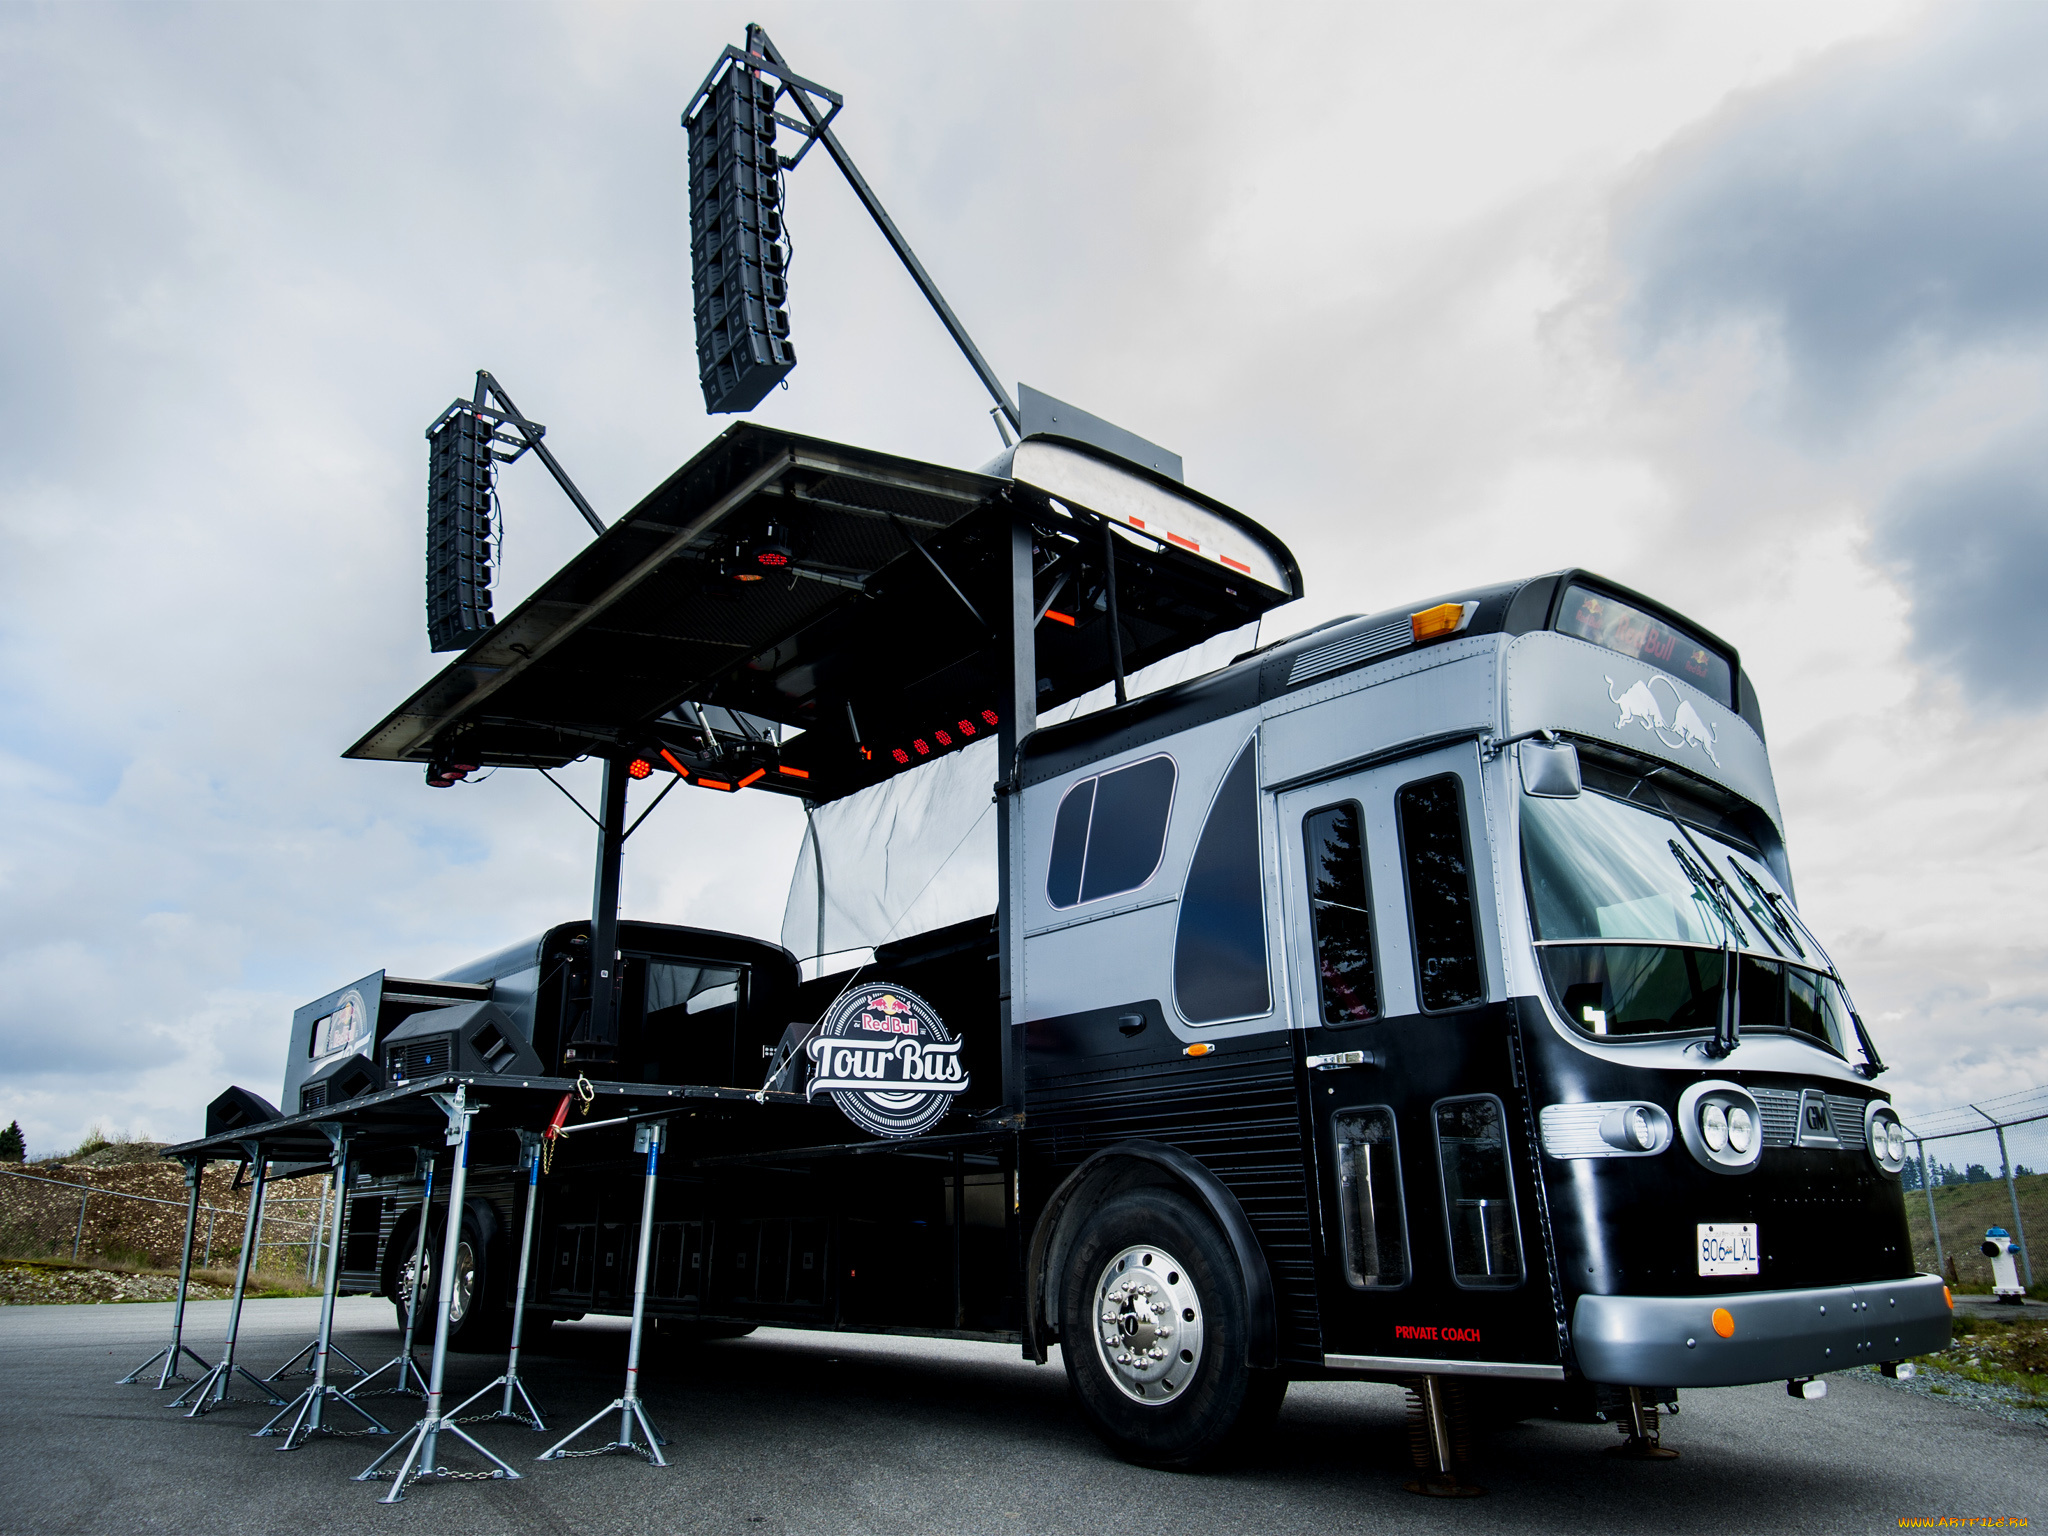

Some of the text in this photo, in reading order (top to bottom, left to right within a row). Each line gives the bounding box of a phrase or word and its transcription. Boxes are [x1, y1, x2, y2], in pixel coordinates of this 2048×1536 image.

[1615, 614, 1676, 661] Red Bull
[861, 1013, 891, 1033] Red
[891, 1016, 919, 1036] Bull
[812, 1033, 962, 1081] Tour Bus
[1806, 1106, 1828, 1131] GM
[1702, 1237, 1756, 1262] 806 LXL
[1395, 1325, 1481, 1342] PRIVATE COACH
